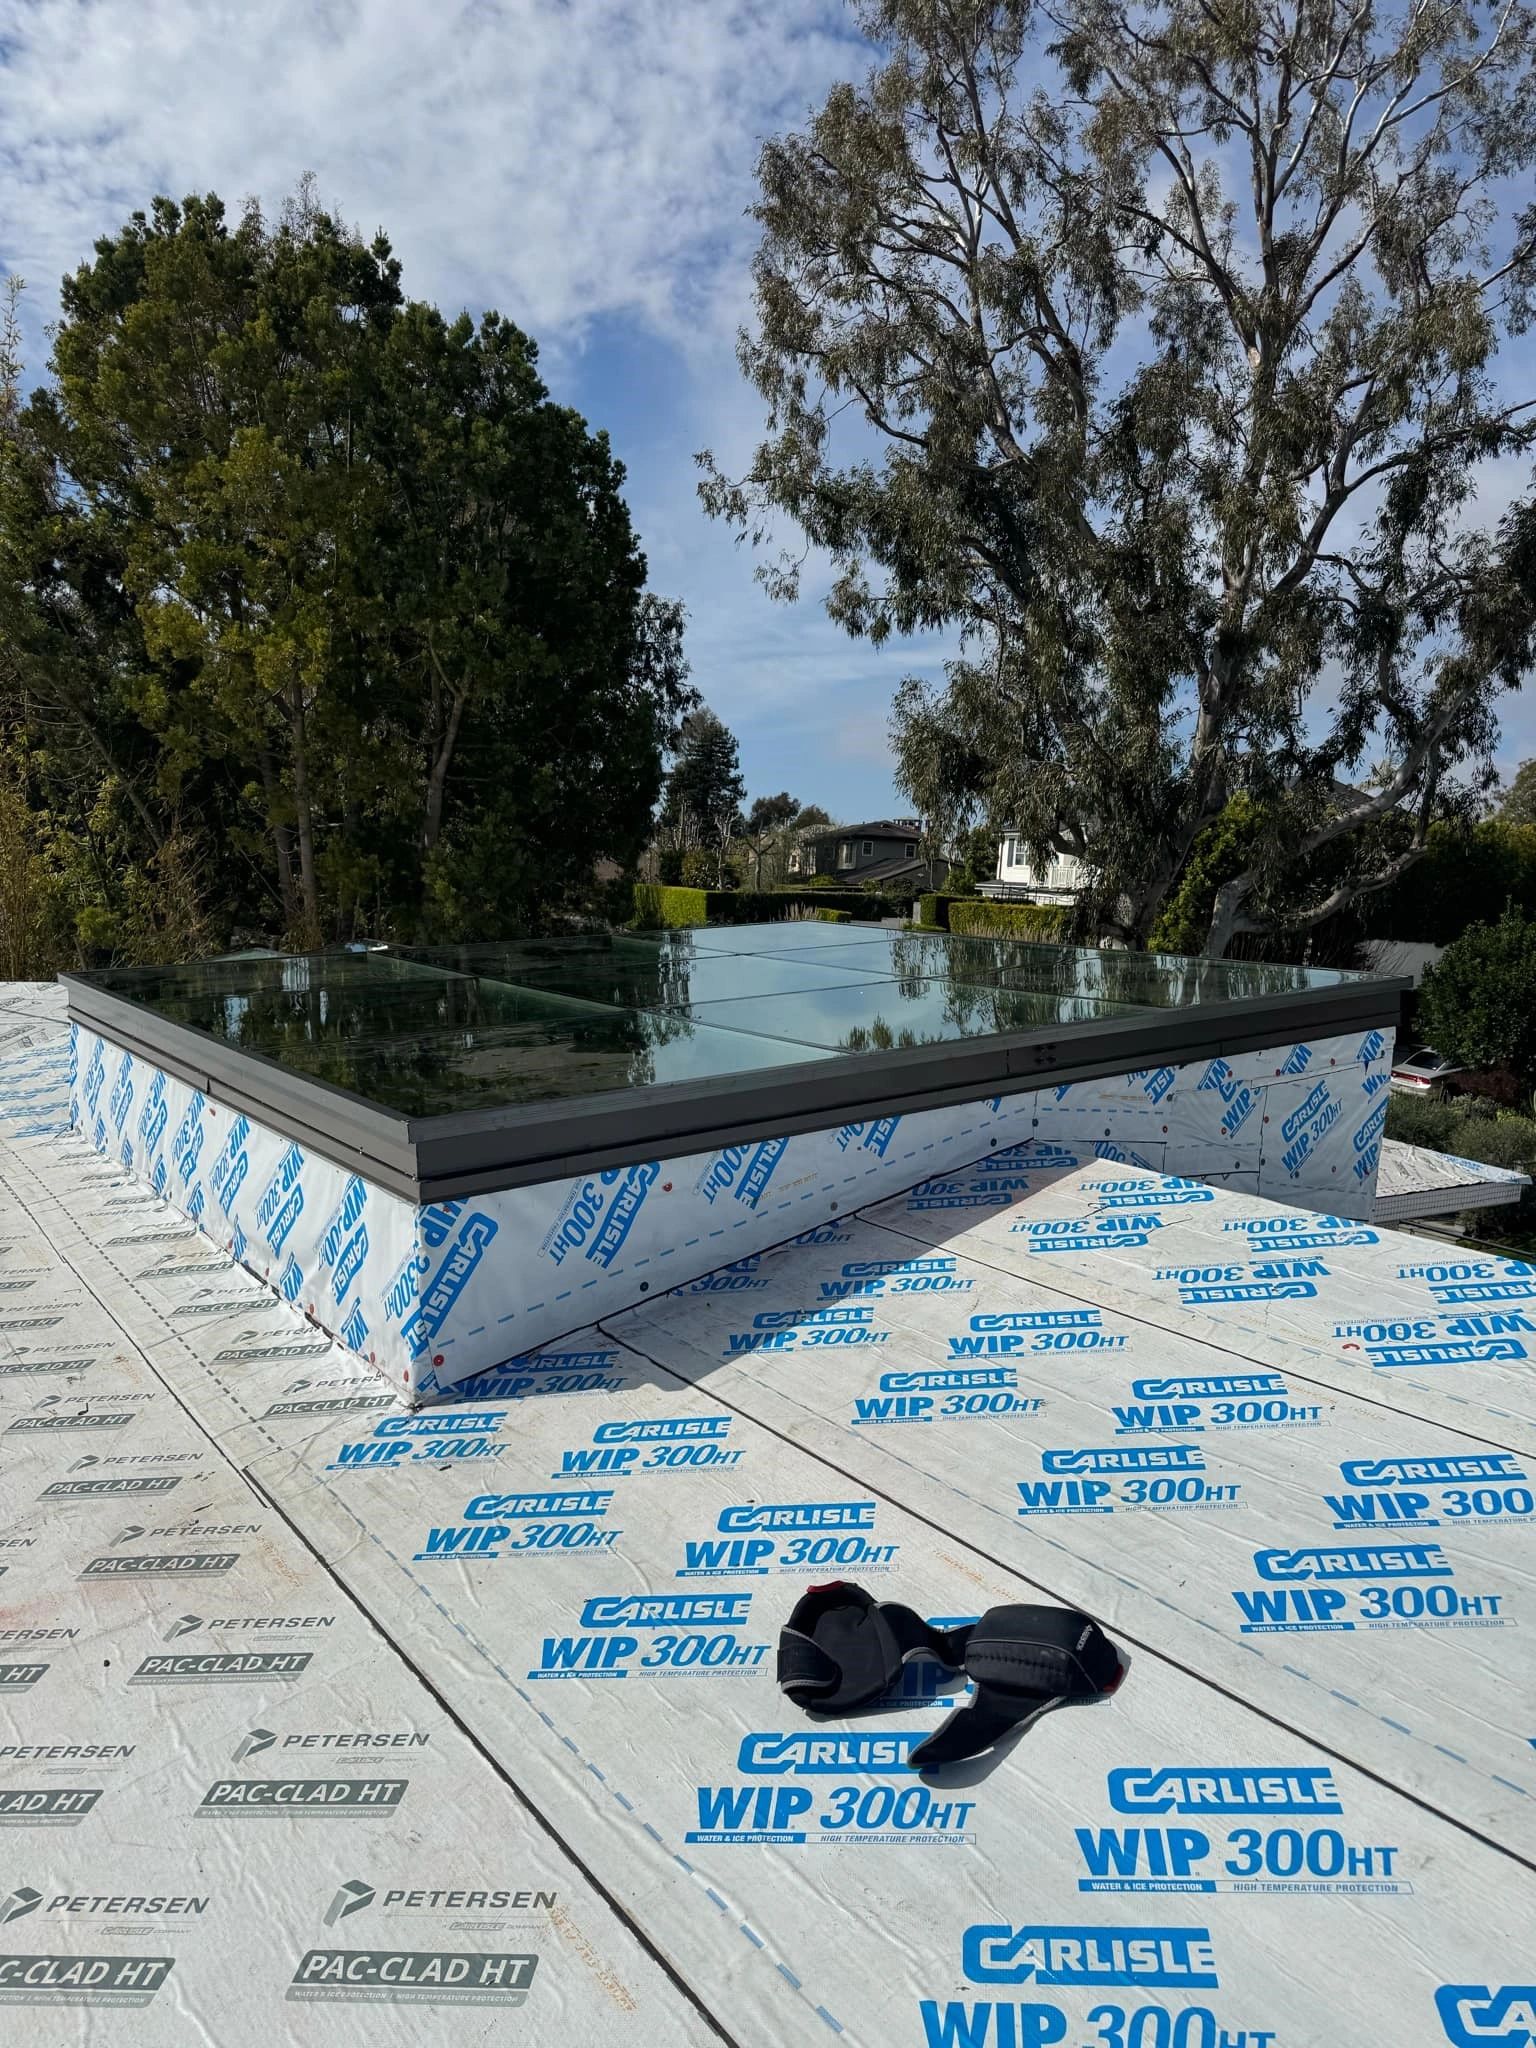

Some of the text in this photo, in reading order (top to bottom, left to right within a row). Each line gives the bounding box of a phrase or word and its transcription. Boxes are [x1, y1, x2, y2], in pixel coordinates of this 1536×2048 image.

[1221, 1088, 1250, 1130] WIP
[1283, 1081, 1329, 1141] CARLISLE
[1282, 1098, 1342, 1172] WIP 300HT
[282, 1146, 304, 1192] WIP
[1080, 1180, 1155, 1193] 300HT
[343, 1178, 367, 1232] WIP
[587, 1163, 659, 1266] CARLISLE
[548, 1182, 604, 1266] 300HT
[1008, 1215, 1163, 1235] WIP 300HT
[1220, 1219, 1308, 1233] 300HT
[1030, 1235, 1146, 1251] CARLISLE
[1248, 1232, 1377, 1250] CARLISLE
[845, 1259, 956, 1275] CARLISLE
[1152, 1260, 1332, 1283] WIP 300HT
[1396, 1263, 1495, 1282] 300HT
[821, 1276, 976, 1296] WIP 300HT
[1179, 1284, 1314, 1302] CARLISLE
[756, 1309, 873, 1327] CARLISLE
[973, 1312, 1101, 1330] CARLISLE
[1446, 1314, 1536, 1337] WIP
[729, 1328, 892, 1350] WIP 300HT
[1332, 1321, 1436, 1341] 300HT
[32, 1342, 116, 1353] PETERSEN
[948, 1335, 1023, 1354] WIP
[1031, 1331, 1129, 1350] 300HT
[1366, 1342, 1524, 1364] CARLISLE
[464, 1374, 628, 1397] WIP 300HT
[883, 1370, 1017, 1389] CARLISLE
[1136, 1377, 1287, 1397] CARLISLE
[64, 1393, 156, 1403] PETERSEN
[364, 1397, 394, 1408] HT
[854, 1393, 1044, 1418] WIP 300HT
[103, 1415, 131, 1424] HT
[376, 1414, 507, 1434] CARLISLE
[1111, 1404, 1200, 1427] WIP
[1210, 1401, 1322, 1424] 300HT
[596, 1419, 732, 1441] CARLISLE
[103, 1453, 204, 1465] PETERSEN
[337, 1438, 511, 1463] WIP 300HT
[562, 1444, 746, 1472] WIP 300HT
[1045, 1448, 1205, 1471] CARLISLE
[1345, 1457, 1527, 1482] CARLISLE
[48, 1479, 173, 1494] PAC-CLAD HT
[1017, 1477, 1241, 1506] WIP 300HT
[468, 1493, 613, 1517] CARLISLE
[1322, 1488, 1535, 1521] WIP 300
[721, 1505, 875, 1530] CARLISLE
[149, 1525, 262, 1537] PETERSEN
[426, 1522, 624, 1552] WIP 300HT
[89, 1556, 235, 1571] PAC-CLAD HT
[685, 1537, 900, 1568] WIP 300HT
[1258, 1548, 1453, 1577] CARLISLE
[583, 1596, 751, 1624] CARLISLE
[1232, 1585, 1502, 1623] WIP 300HT
[0, 1628, 81, 1640] ERSEN
[208, 1616, 336, 1630] PETERSEN
[1453, 1619, 1505, 1627] PROTECTION
[541, 1634, 772, 1669] WIP 300HT
[4, 1667, 43, 1681] HT
[142, 1655, 307, 1673] PAC-CLAD HT
[903, 1661, 957, 1697] IP
[282, 1733, 430, 1748] PETERSEN
[0, 1745, 136, 1759] PETERSEN
[742, 1737, 924, 1769] CARLISL
[50, 1793, 96, 1811] HT
[210, 1783, 401, 1803] PAC-CLAD HT
[1113, 1773, 1343, 1809] CARLISLE
[697, 1786, 975, 1829] WIP 300HT
[697, 1834, 793, 1843] WATER & ICE PROTECTION
[821, 1834, 964, 1843] HIGH TEMPERATURE PROTECTION
[1075, 1828, 1398, 1876] WIP 300HT
[1092, 1882, 1202, 1891] WATER & ICE PROTECTION
[1233, 1883, 1398, 1893] HIGH TEMPERATURE PROTECTION
[46, 1895, 210, 1913] PETERSEN
[382, 1890, 557, 1909] PETERSEN
[969, 1931, 1218, 1982] CARLISLE
[0, 1960, 167, 1986] C-CLAD HT
[302, 1955, 530, 1984] PAC-CLAD HT
[919, 2001, 1067, 2048] WIP
